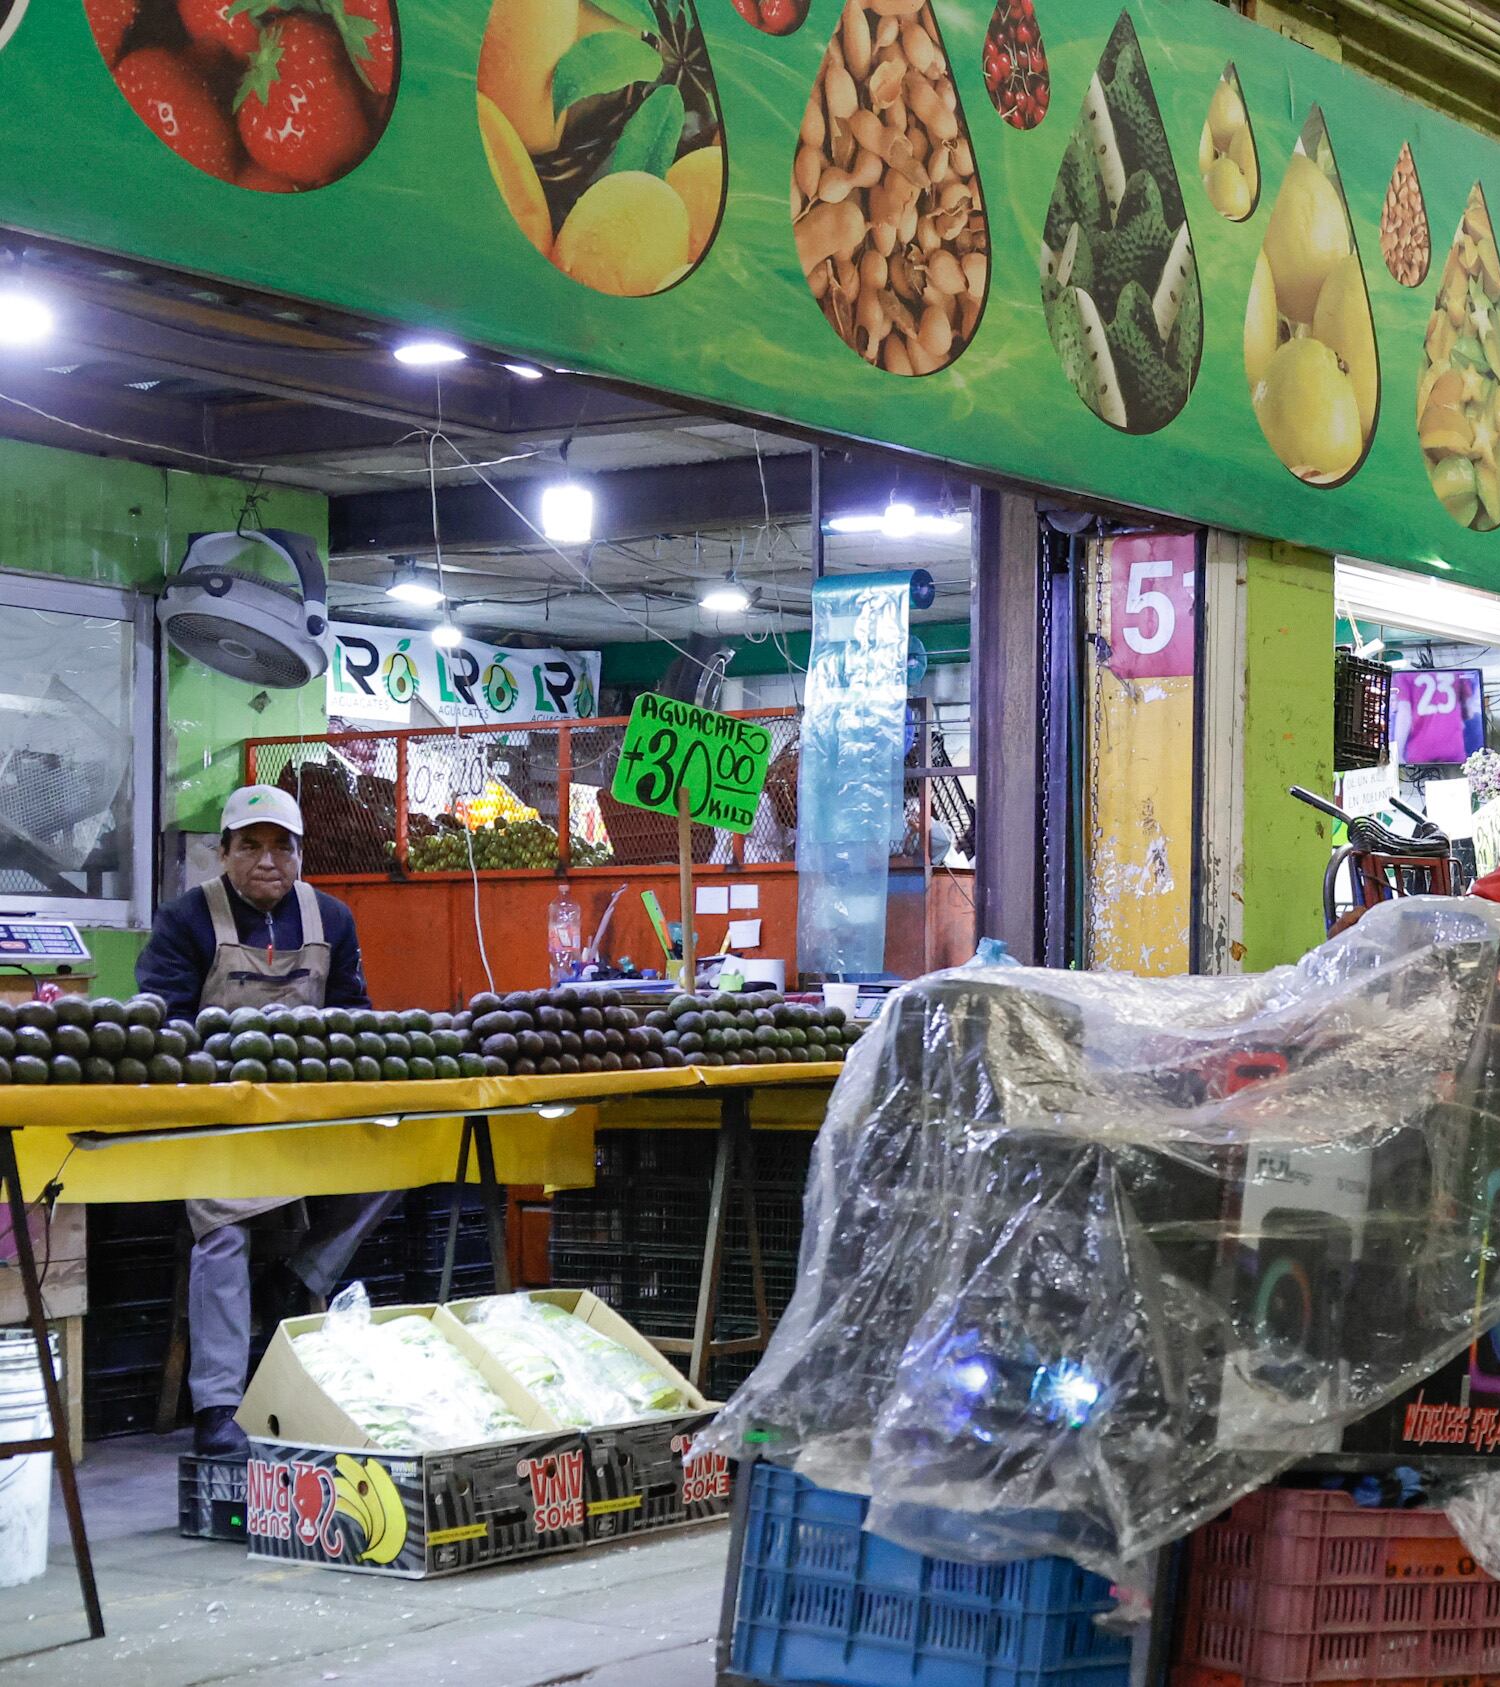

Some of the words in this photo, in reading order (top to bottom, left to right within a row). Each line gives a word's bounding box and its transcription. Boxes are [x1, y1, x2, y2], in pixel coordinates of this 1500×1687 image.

[1122, 560, 1195, 655] 5
[1413, 671, 1457, 716] 23
[1402, 1389, 1471, 1446] WIRELESS
[247, 1459, 290, 1514] BAN
[682, 1472, 730, 1504] EMOS
[534, 1502, 584, 1533] EMOS
